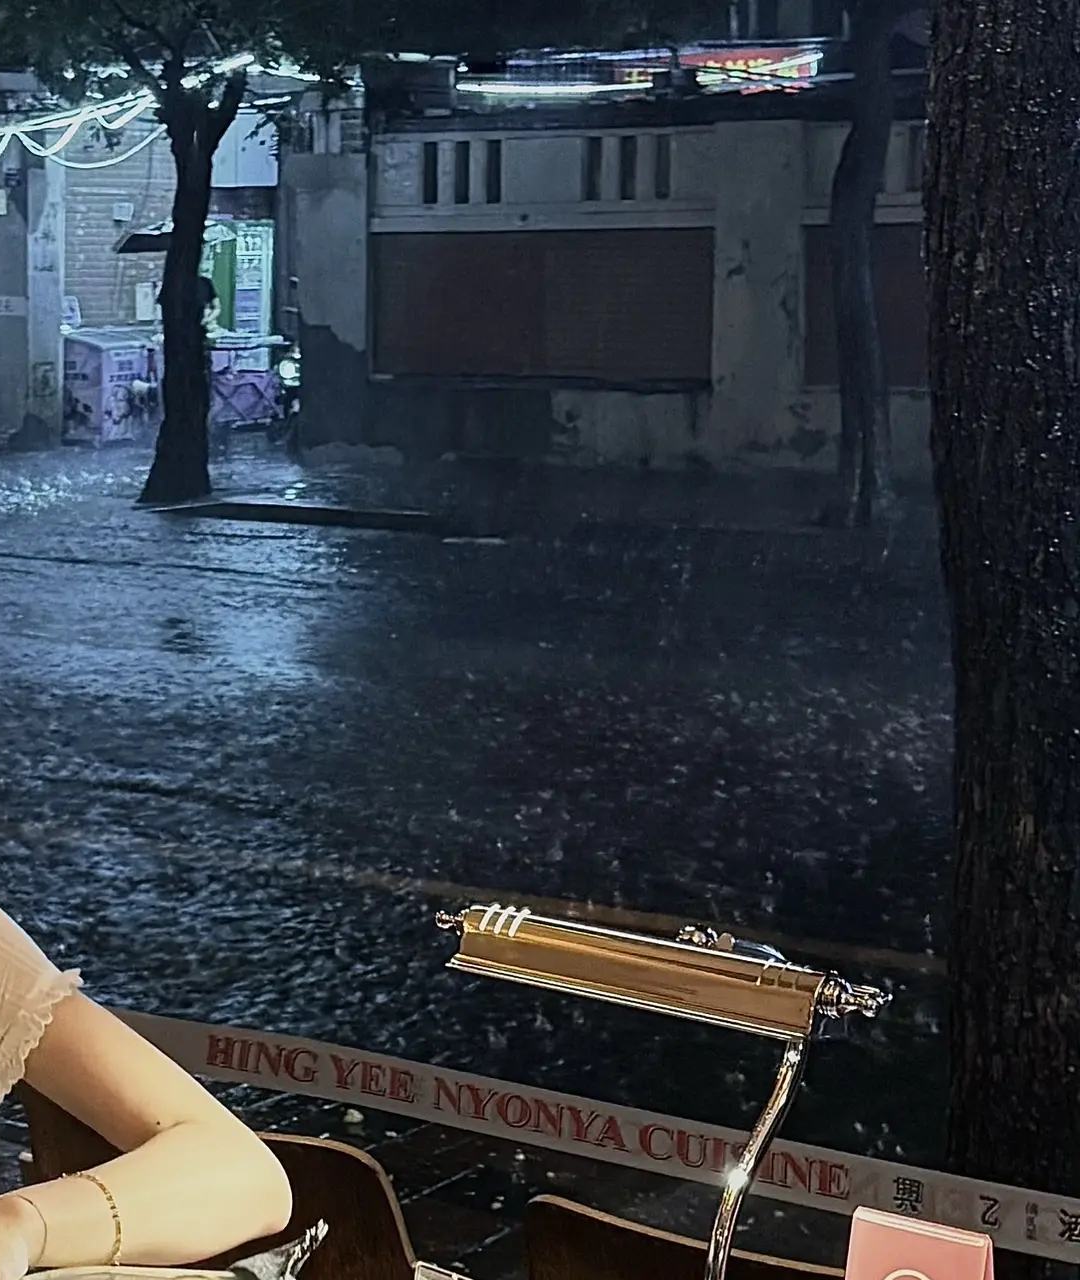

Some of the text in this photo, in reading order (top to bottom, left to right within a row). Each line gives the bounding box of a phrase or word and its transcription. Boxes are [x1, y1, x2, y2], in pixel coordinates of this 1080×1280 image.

[206, 1034, 318, 1084] HING
[329, 1052, 415, 1104] YEE
[432, 1076, 629, 1152] NYONYA
